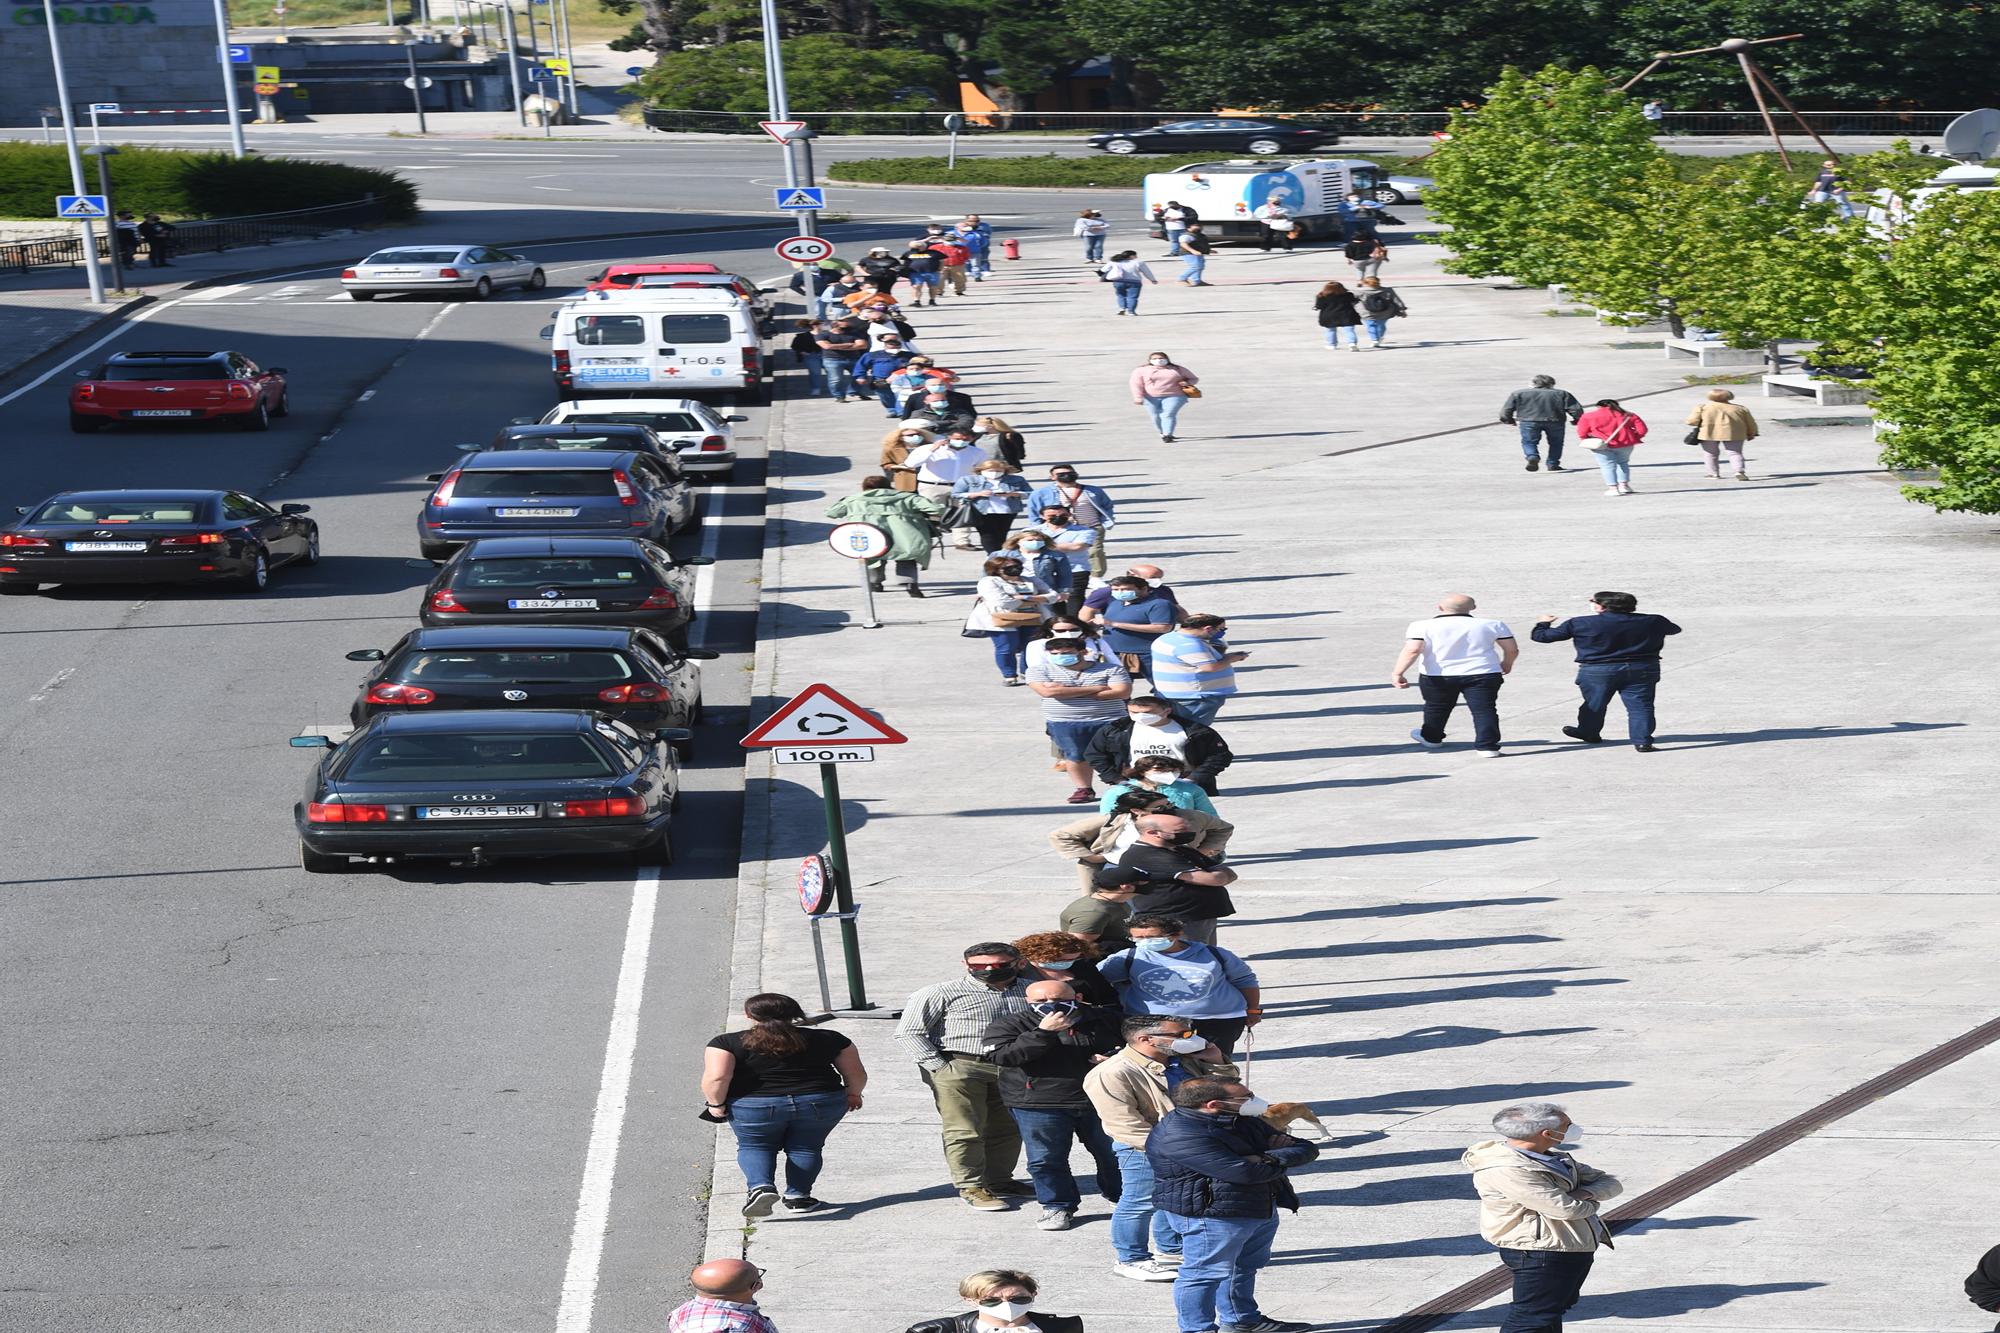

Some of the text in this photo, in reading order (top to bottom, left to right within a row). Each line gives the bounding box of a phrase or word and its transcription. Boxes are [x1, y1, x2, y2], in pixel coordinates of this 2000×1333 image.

[788, 245, 822, 254] 40
[582, 368, 648, 376] SEMUS
[429, 806, 529, 817] C 9435 BK
